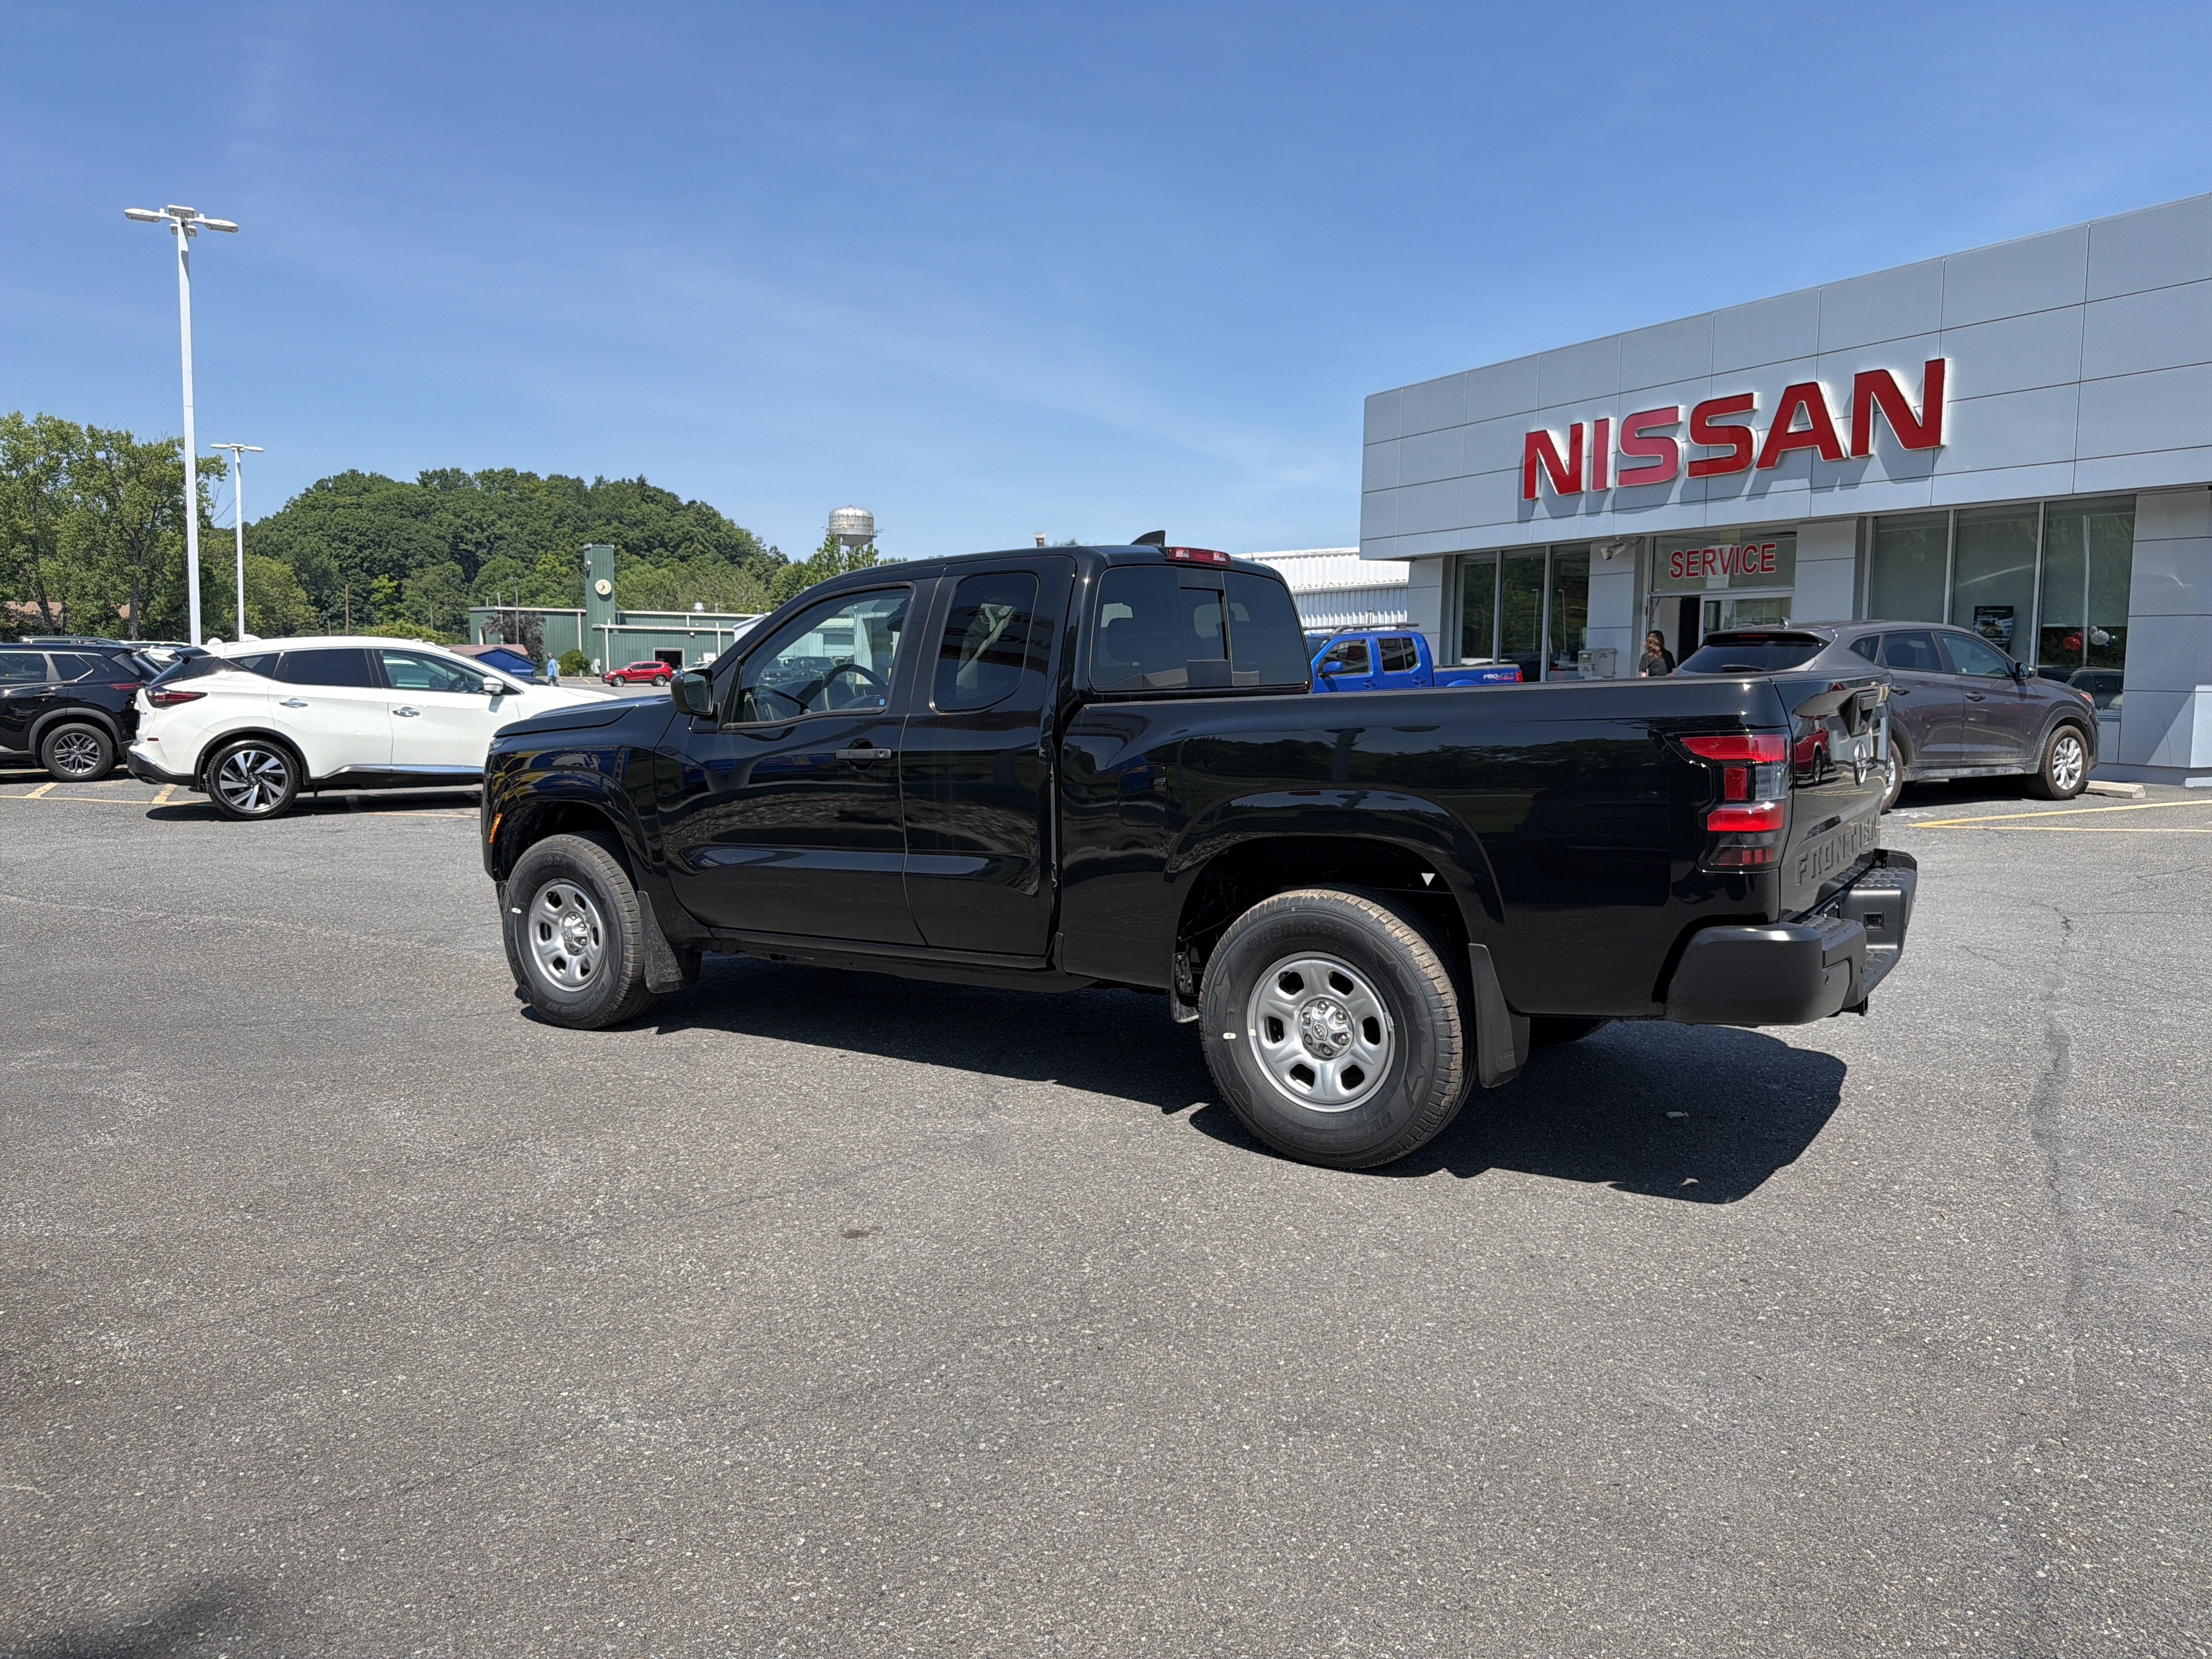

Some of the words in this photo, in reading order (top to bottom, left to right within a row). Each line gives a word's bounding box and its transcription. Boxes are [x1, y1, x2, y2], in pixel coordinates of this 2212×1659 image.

[1522, 358, 1948, 500] NISSAN
[1669, 542, 1776, 579] SERVICE
[1795, 814, 1877, 887] FRONTIER
